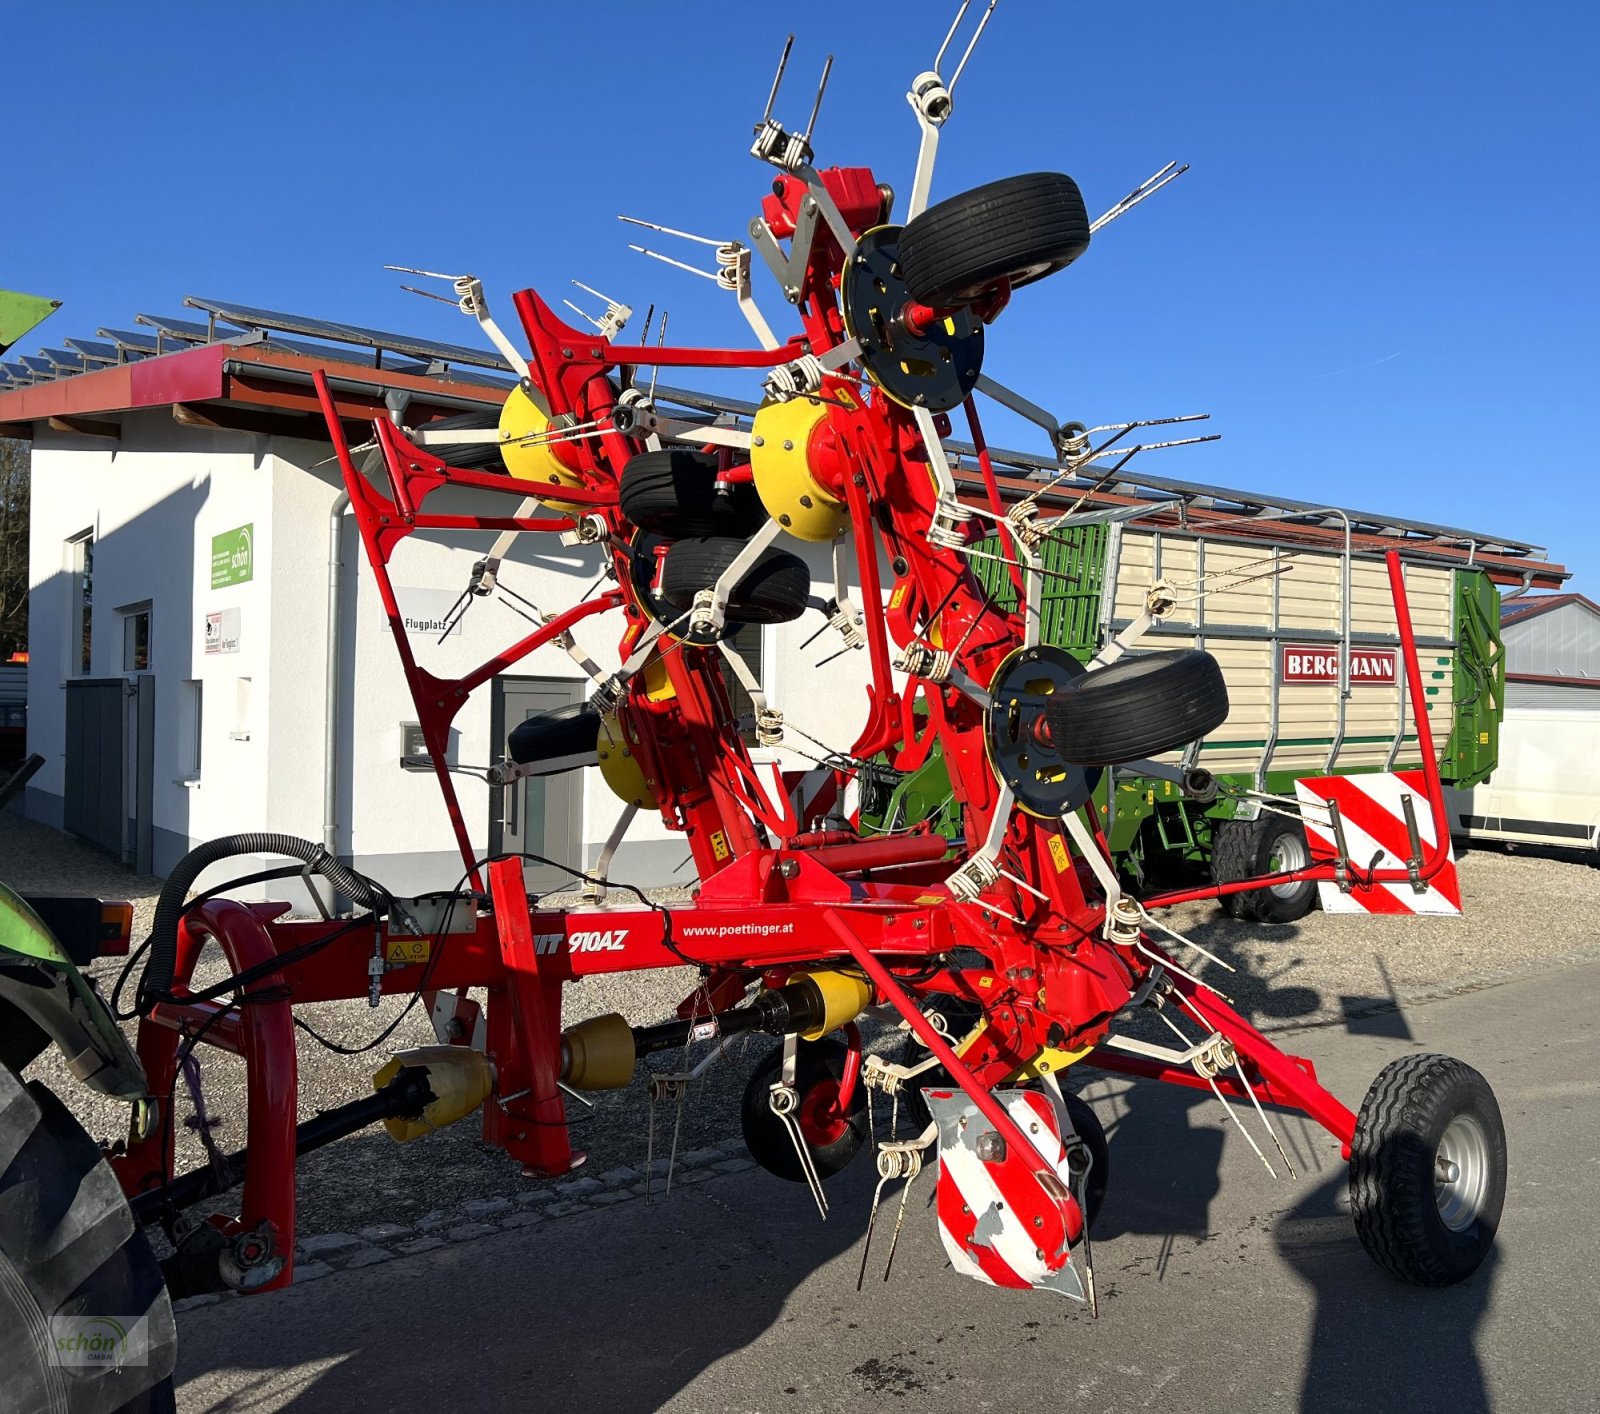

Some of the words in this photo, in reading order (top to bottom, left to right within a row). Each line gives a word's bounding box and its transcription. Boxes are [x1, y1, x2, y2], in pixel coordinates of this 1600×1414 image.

[405, 618, 447, 631] Flugplatz
[683, 923, 794, 938] www.poettinger.at
[568, 930, 629, 953] 910AZ
